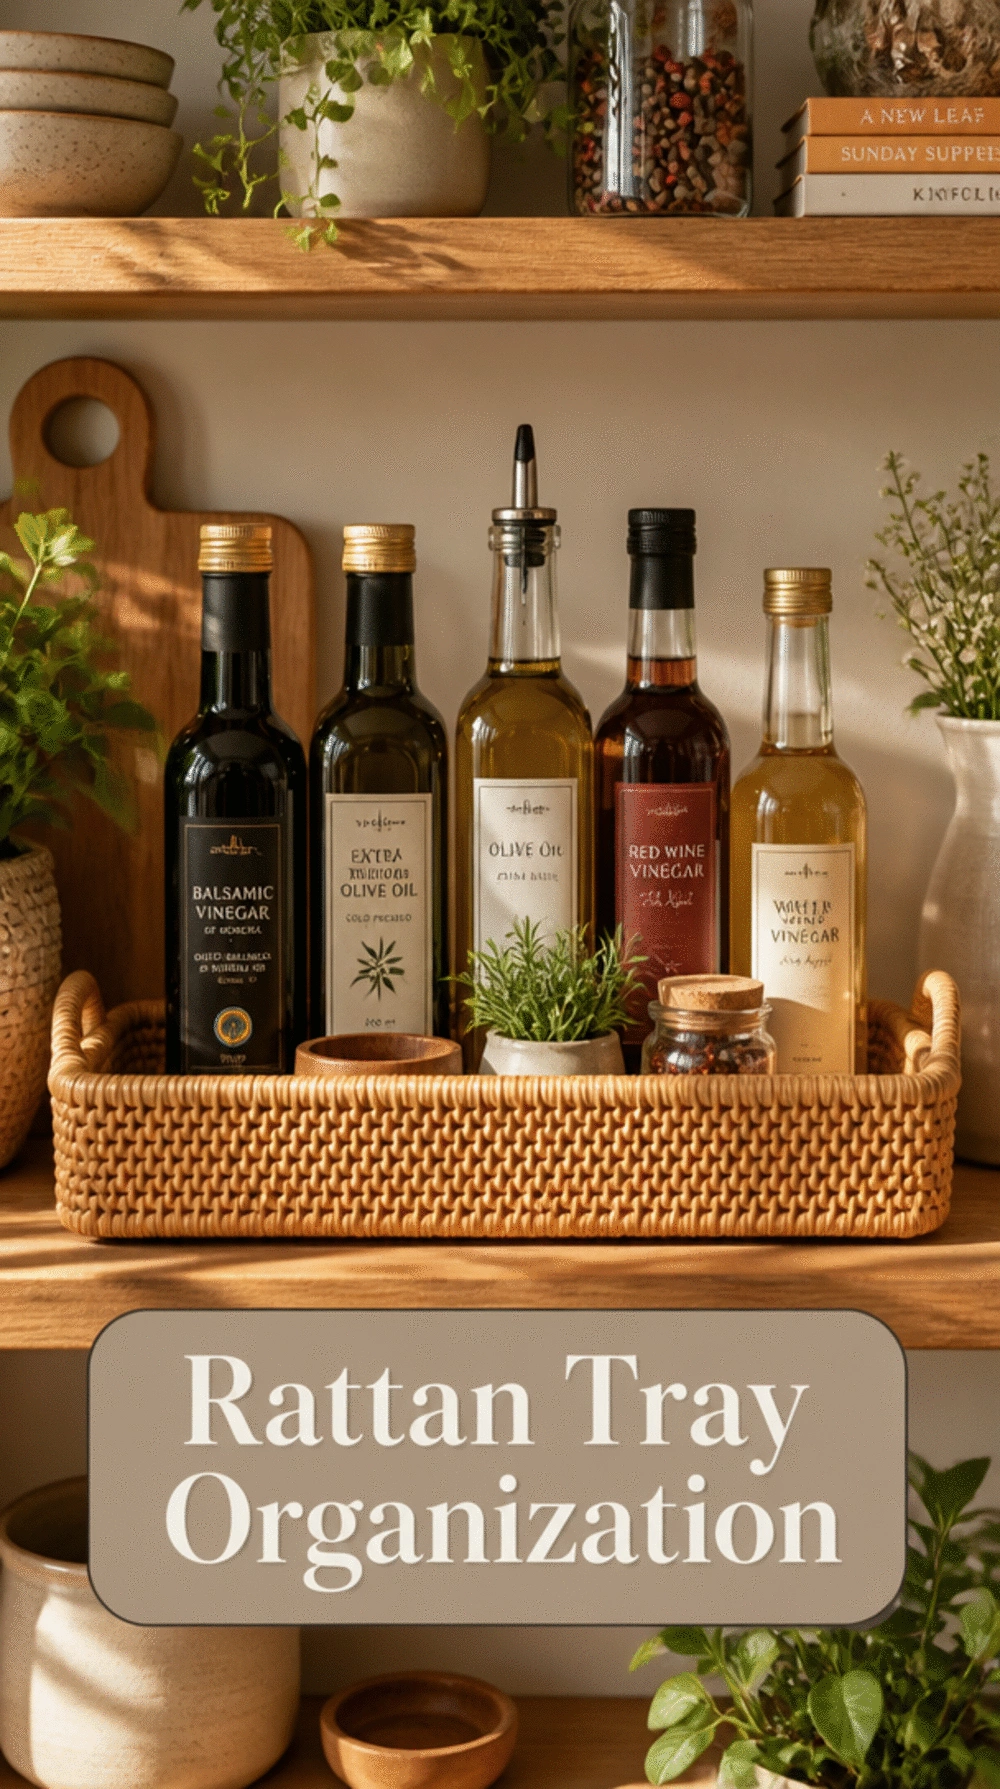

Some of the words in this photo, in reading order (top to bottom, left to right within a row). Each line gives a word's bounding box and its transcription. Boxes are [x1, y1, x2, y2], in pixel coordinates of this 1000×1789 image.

[859, 108, 874, 125] A
[881, 107, 927, 125] NEW
[933, 107, 985, 124] LEAF
[841, 146, 918, 162] SUNDAY
[488, 841, 534, 858] OLIVE
[628, 844, 660, 859] RED
[664, 844, 705, 859] WINE
[629, 862, 705, 879] VINEGAR
[192, 885, 274, 900] BALSAMIC
[340, 883, 387, 898] OLIVE
[392, 882, 418, 898] OIL
[195, 905, 271, 920] VINEGAR
[771, 927, 840, 944] VINEGAR
